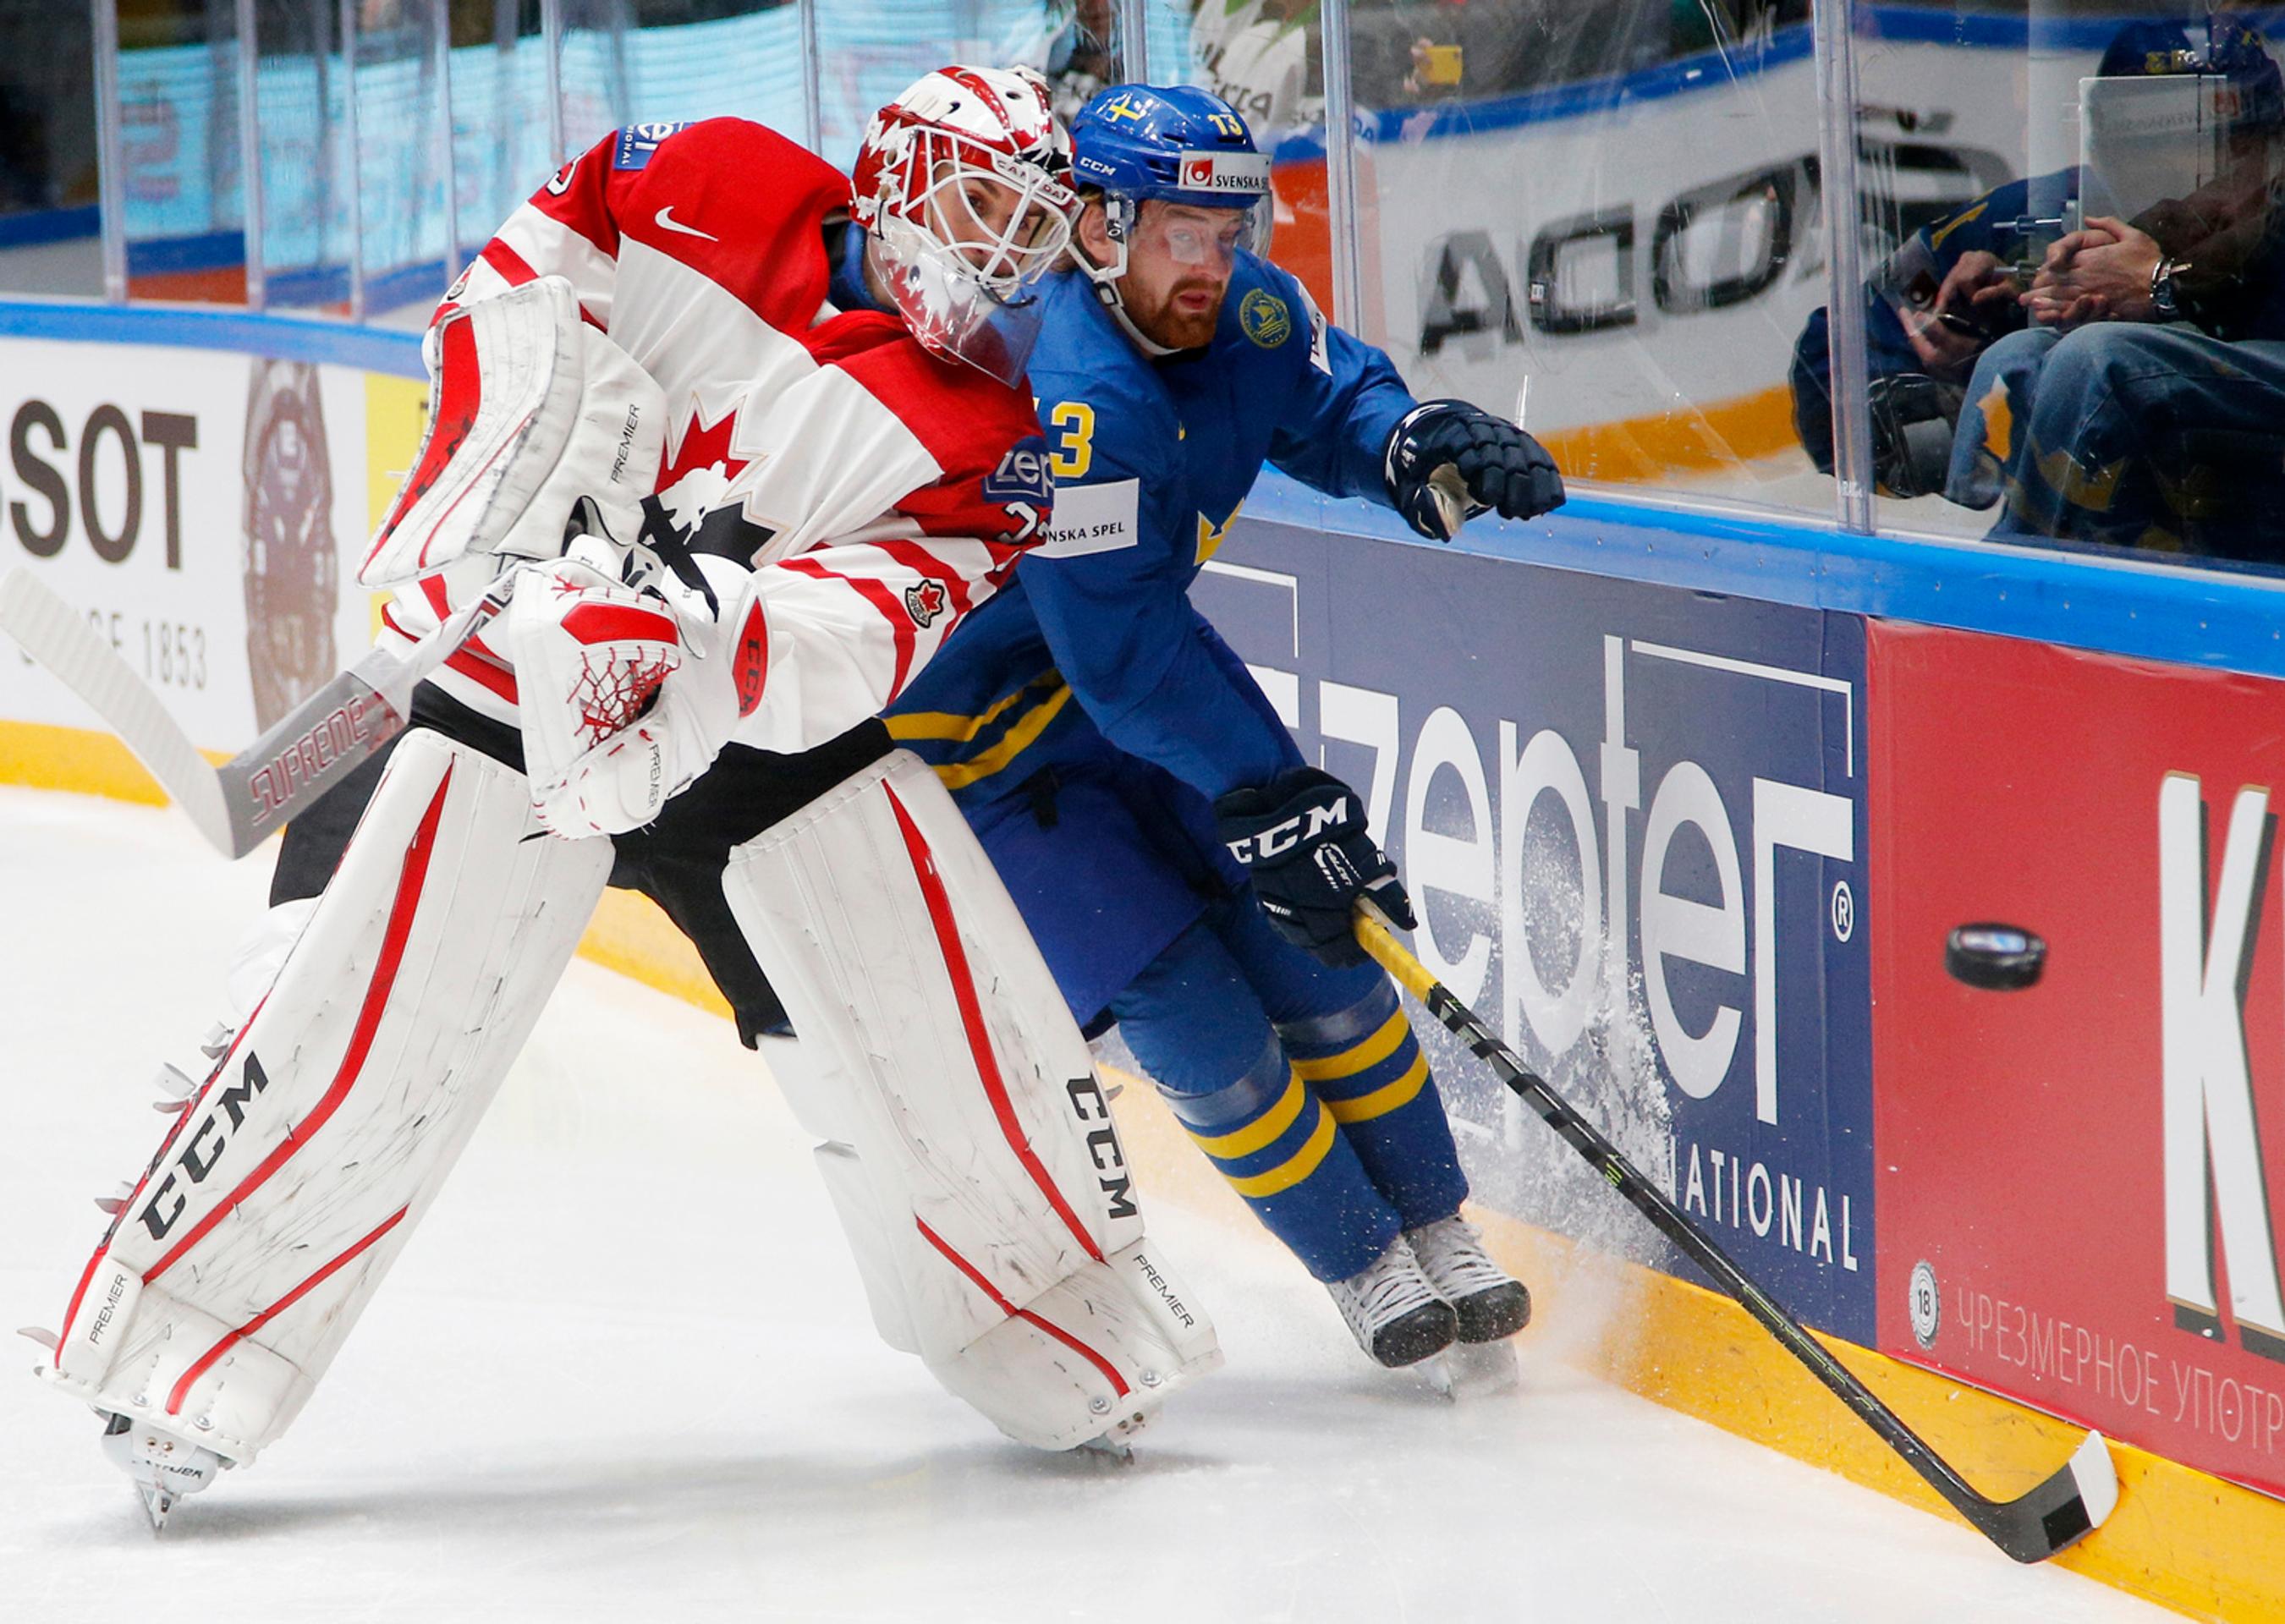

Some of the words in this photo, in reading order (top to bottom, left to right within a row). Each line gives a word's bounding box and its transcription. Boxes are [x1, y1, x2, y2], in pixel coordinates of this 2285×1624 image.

[1079, 156, 1117, 176] CCM
[1215, 174, 1261, 189] SVENSKA
[610, 403, 640, 485] PREMIER
[996, 449, 1055, 498] zep
[1033, 398, 1095, 479] 3
[0, 398, 197, 570] SOT
[1046, 528, 1086, 543] NSKA
[1092, 522, 1124, 538] SPEL
[143, 618, 207, 690] 1853
[739, 639, 761, 713] CCM
[248, 695, 370, 826] SUPREME
[1226, 796, 1347, 864] CCM
[1320, 634, 1854, 1148] zepter
[2159, 771, 2285, 1341] K
[136, 1050, 269, 1241] CCM
[1065, 1073, 1138, 1221] CCM
[89, 1273, 128, 1346] PREMIER
[1133, 1254, 1195, 1330] PREMIER
[1917, 1290, 1931, 1317] 18
[1958, 1287, 2160, 1415] ЧРЕЗМЕРНОЕ
[2172, 1360, 2285, 1455] УПОТР
